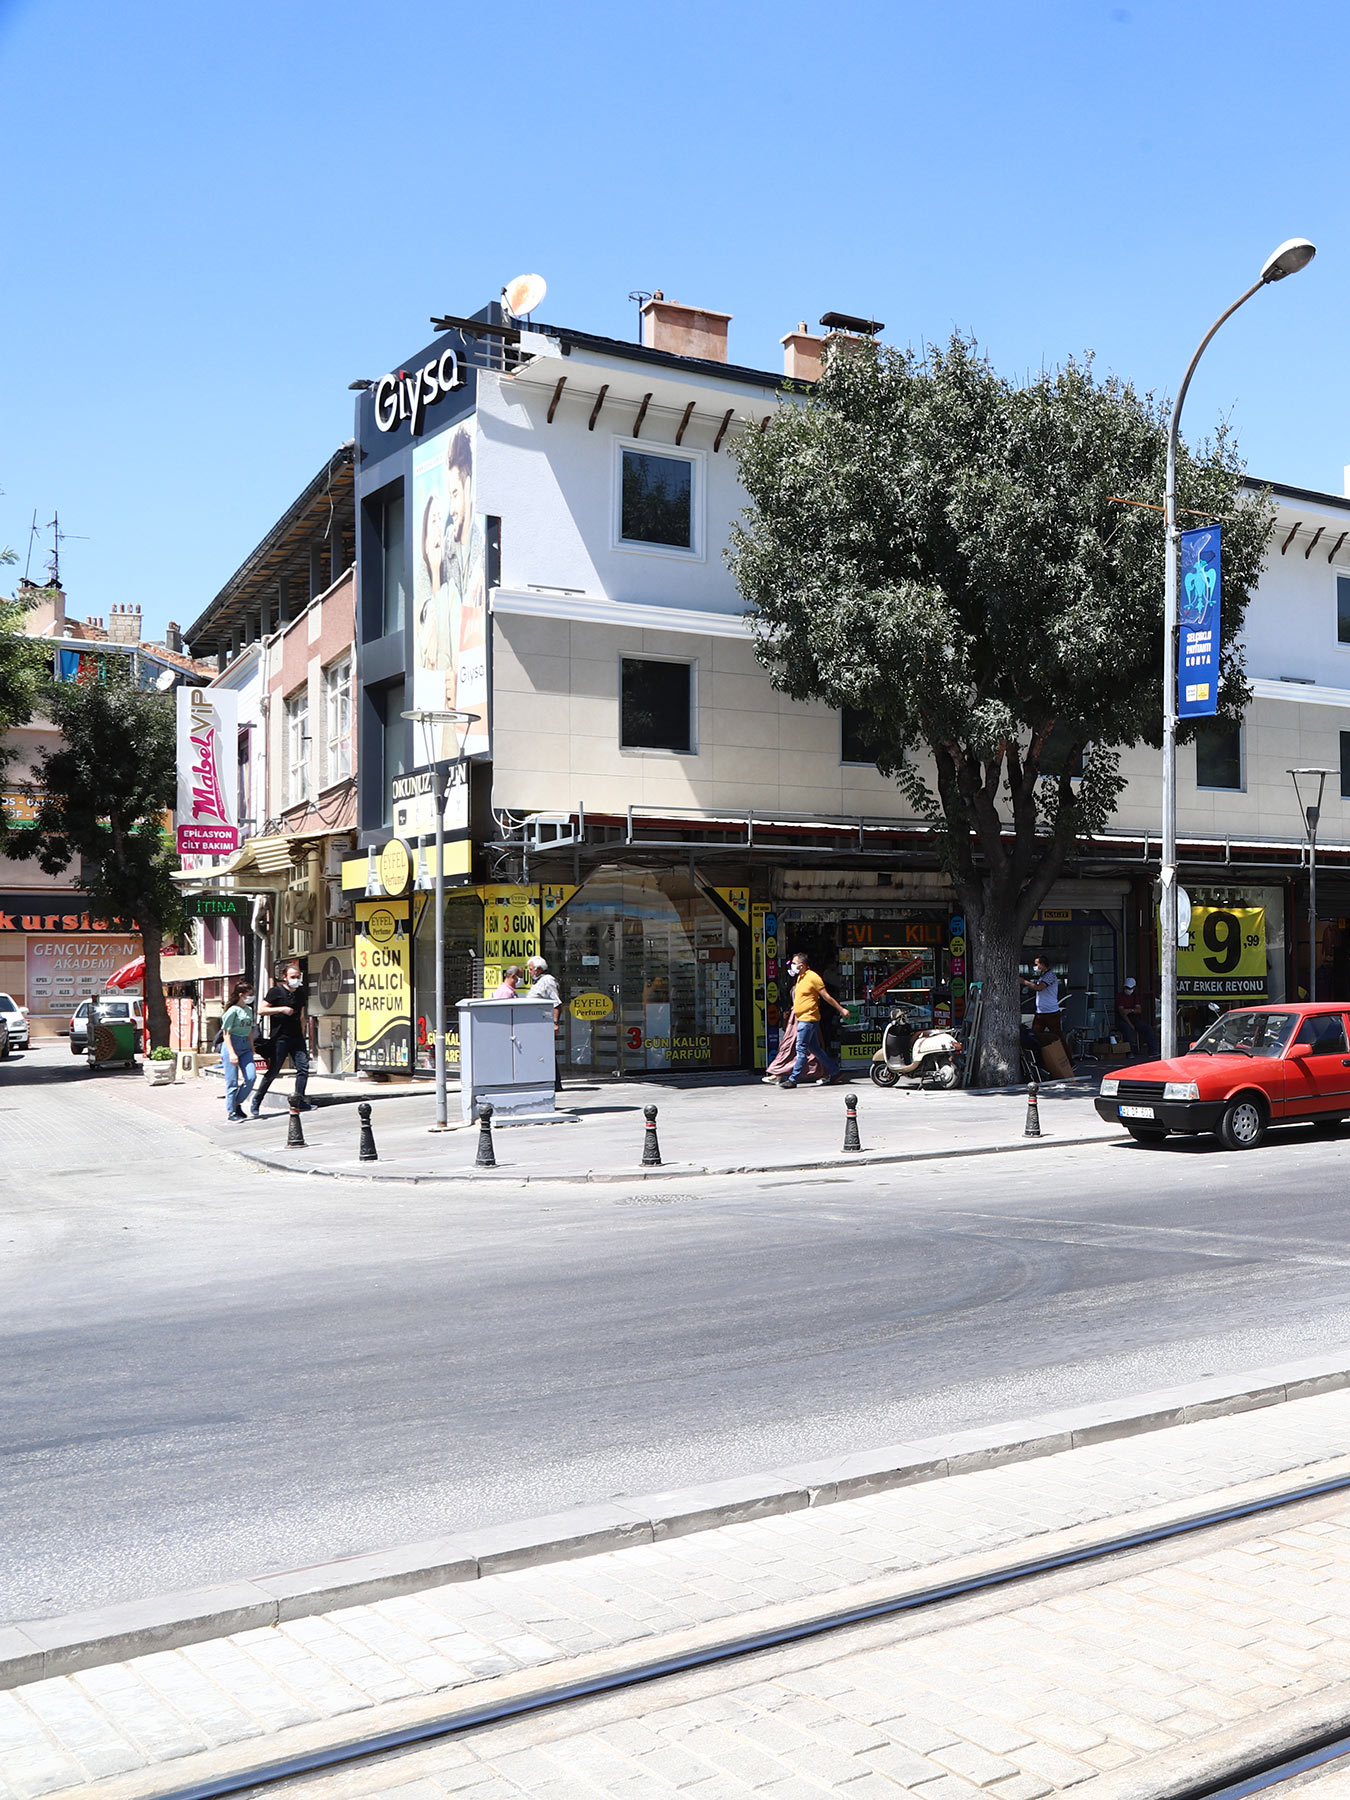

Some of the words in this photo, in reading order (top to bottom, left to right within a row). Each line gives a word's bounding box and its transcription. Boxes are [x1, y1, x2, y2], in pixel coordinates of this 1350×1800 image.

[375, 348, 460, 436] Giysa
[1185, 654, 1211, 667] KONYA
[460, 664, 484, 686] Giysa
[190, 727, 228, 824] Mabel
[392, 772, 431, 799] OKUNUZ
[183, 829, 233, 839] EPİLASYON
[182, 840, 200, 850] CİLT
[202, 841, 234, 850] BAKIMI
[384, 851, 406, 870] EYFEL
[385, 874, 405, 887] Perfume
[371, 916, 393, 926] EYFEL
[503, 915, 509, 933] 3
[512, 912, 535, 933] GÜN
[502, 940, 536, 957] KALICI
[1203, 911, 1241, 974] 9
[53, 955, 115, 970] AKADEMİ
[360, 951, 367, 967] 3
[372, 946, 401, 967] GÜN
[359, 973, 403, 990] KALICI
[1193, 981, 1223, 992] ERKEK
[1225, 980, 1264, 992] REYONU
[359, 992, 403, 1011] PARFÜM
[573, 999, 609, 1008] EYFEL
[576, 1009, 607, 1018] Perfume
[417, 1016, 427, 1045] 3
[627, 1027, 642, 1049] 3
[861, 1033, 882, 1043] SIFIR
[445, 1032, 461, 1046] KAL
[644, 1035, 669, 1048] GÜN
[673, 1036, 710, 1048] KALICI
[665, 1048, 711, 1060] PARFÜM
